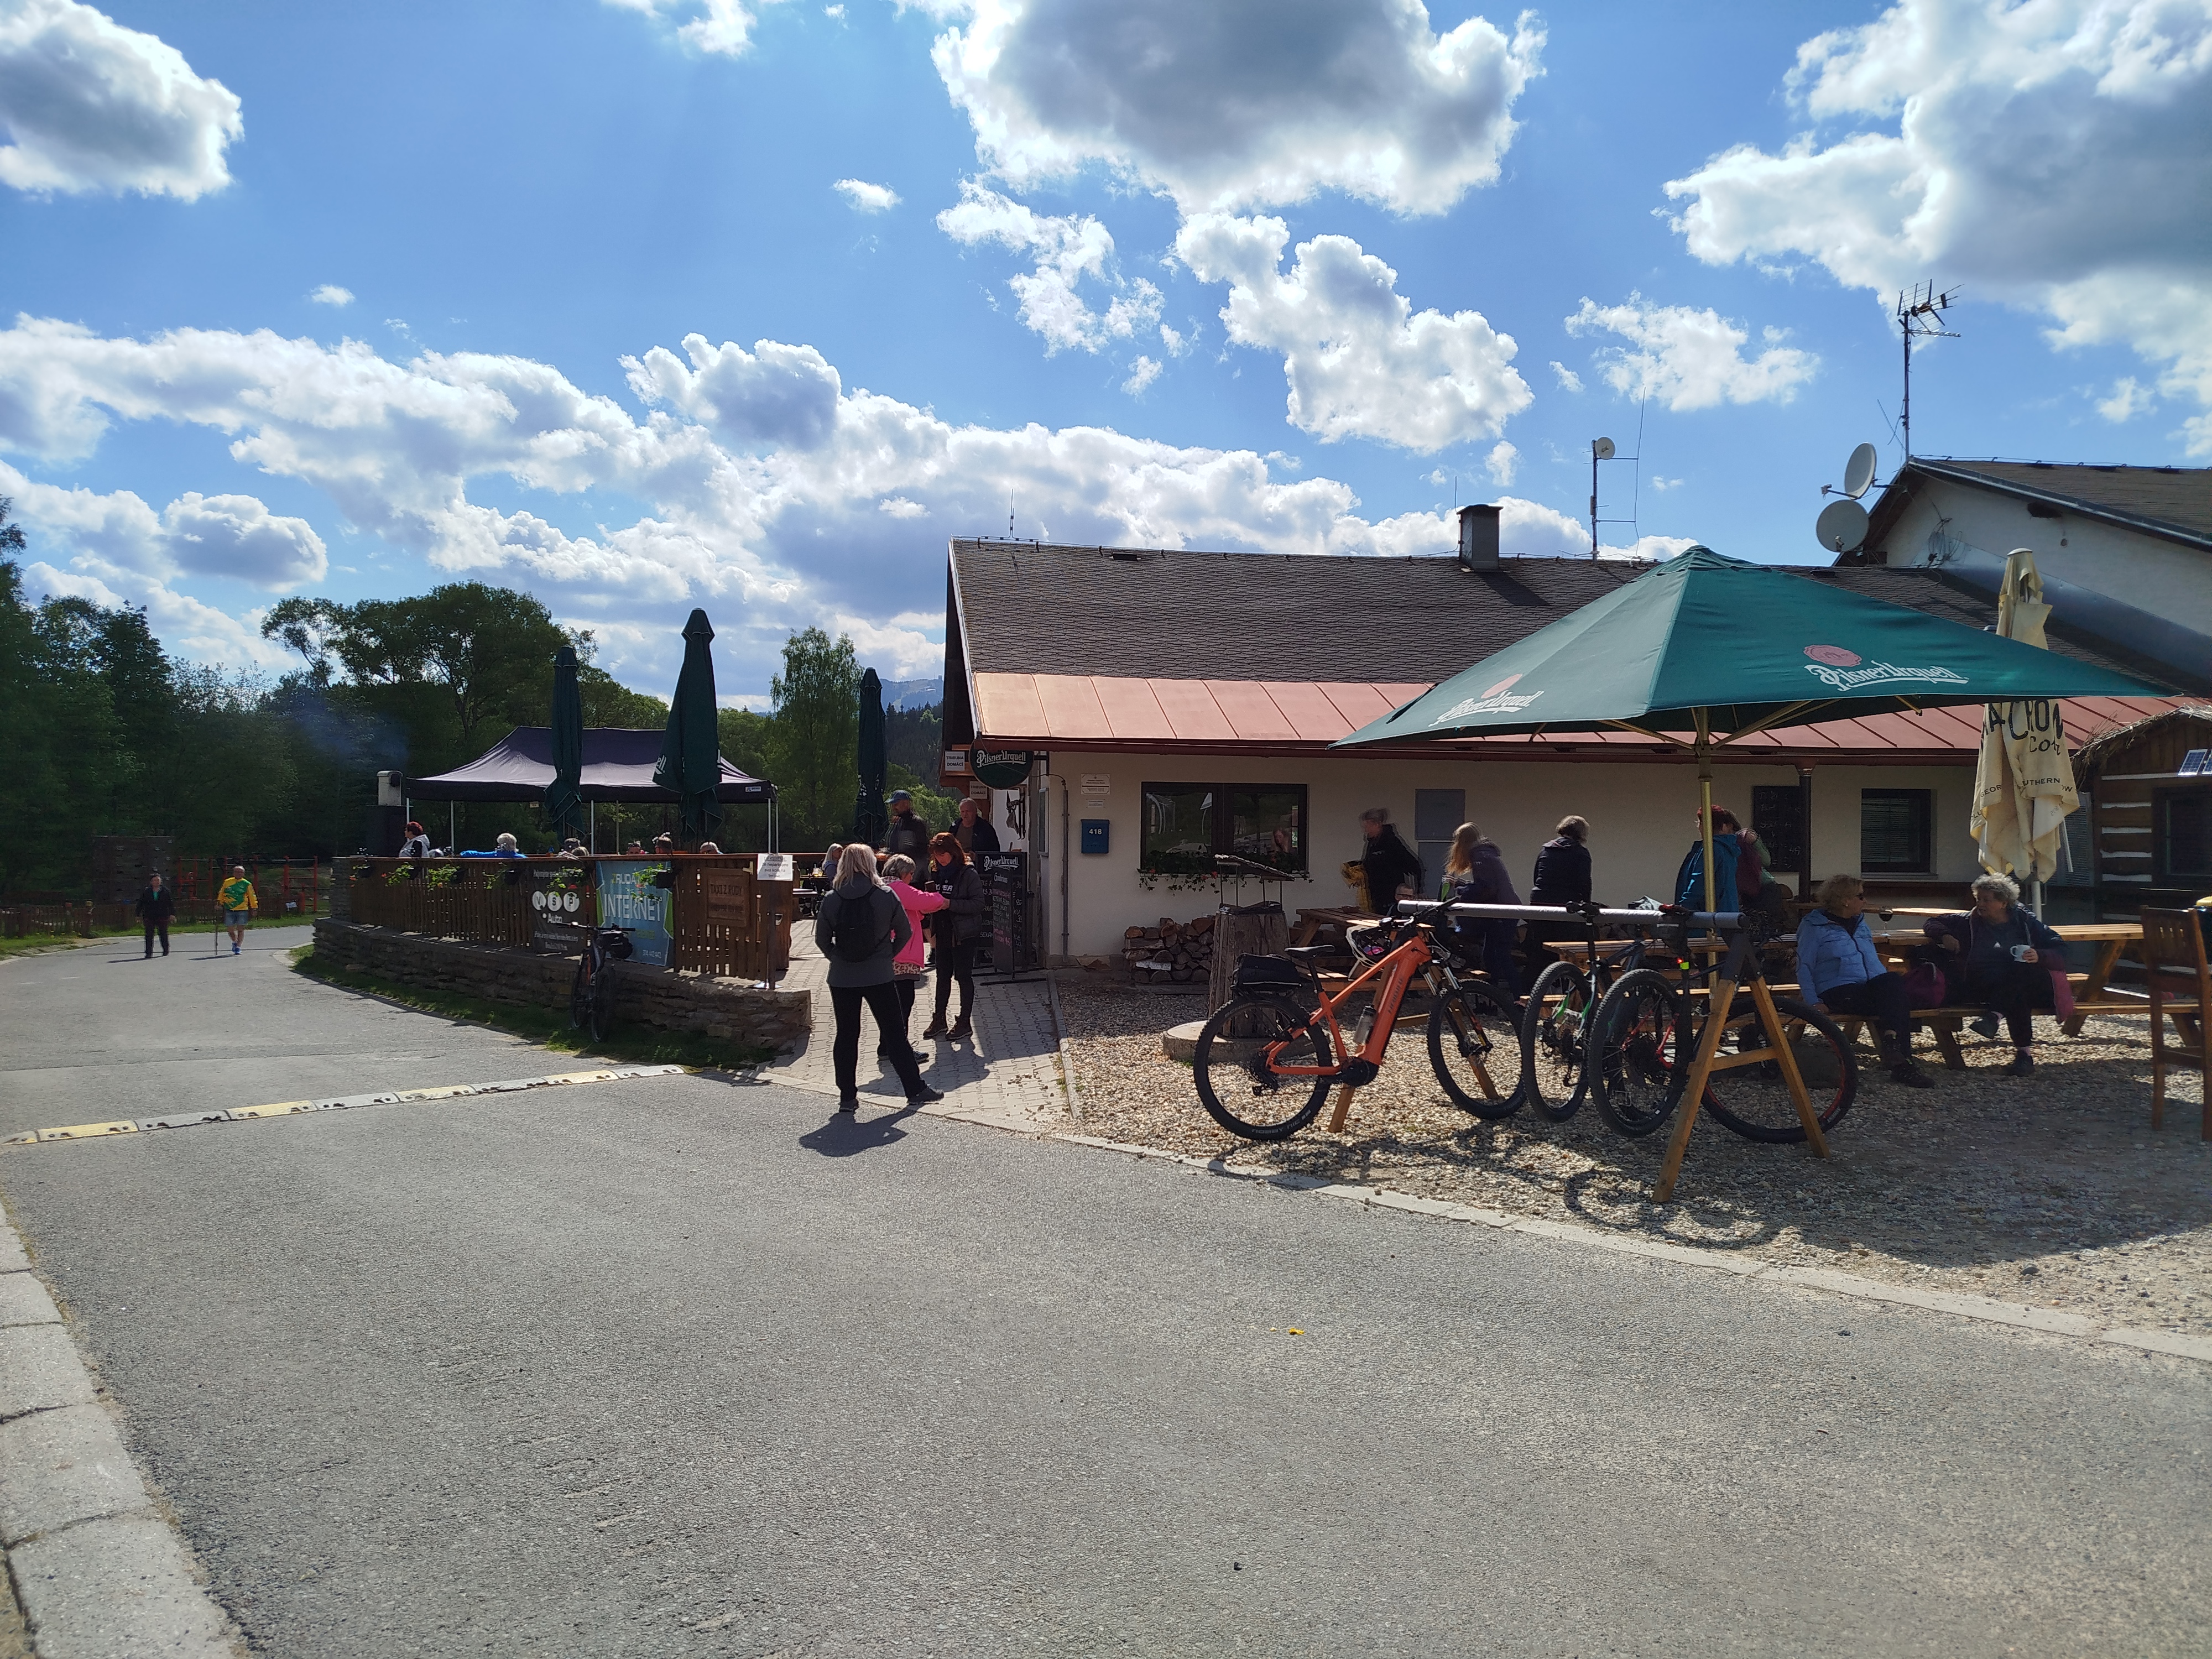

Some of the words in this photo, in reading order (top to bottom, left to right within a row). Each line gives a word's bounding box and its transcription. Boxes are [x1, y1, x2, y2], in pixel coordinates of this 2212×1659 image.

[1804, 664, 1888, 692] Pilsner
[1871, 660, 1970, 684] Urquell
[1428, 698, 1495, 727] Pilsner
[1491, 690, 1545, 714] Urquell
[977, 750, 1003, 768] Pilsner
[1001, 749, 1026, 765] Urquell
[984, 855, 1001, 871] Pilsner
[1000, 855, 1018, 869] Urquell
[547, 913, 563, 924] Auto
[604, 893, 662, 921] INTERNET
